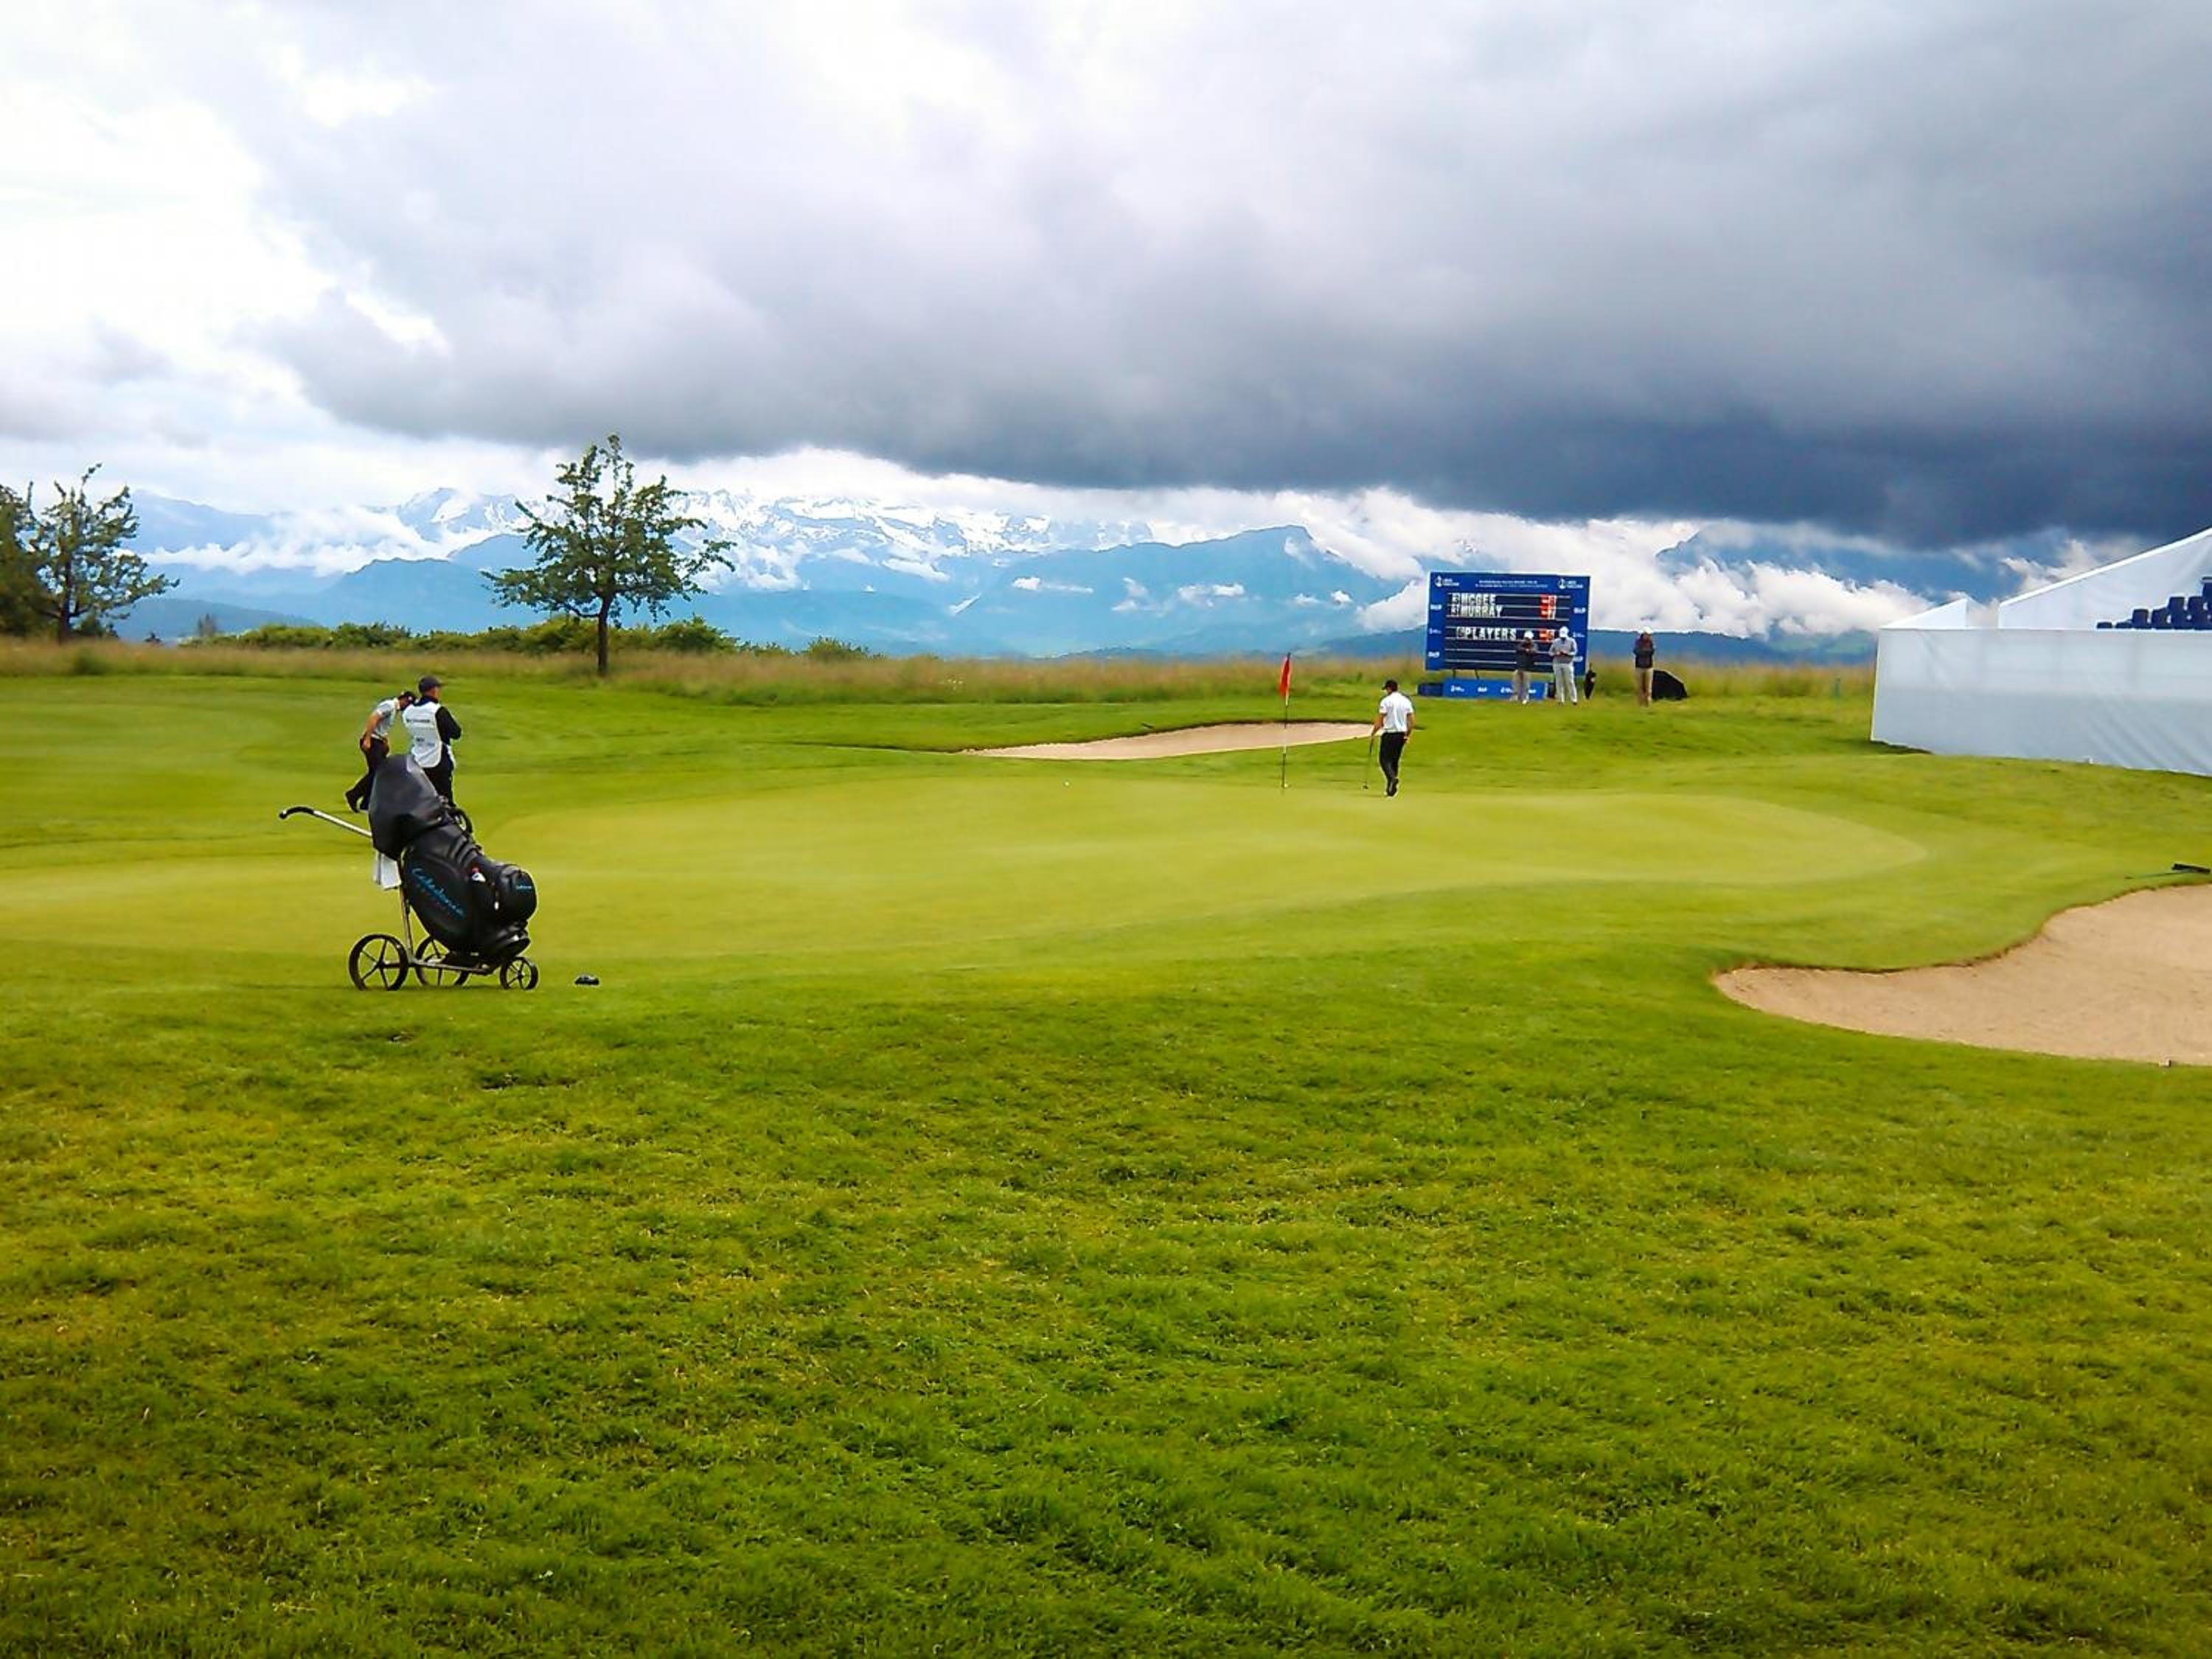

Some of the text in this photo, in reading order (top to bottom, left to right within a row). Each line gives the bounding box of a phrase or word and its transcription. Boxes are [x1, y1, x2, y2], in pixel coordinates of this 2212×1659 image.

[1461, 593, 1496, 605] MCGEE
[1461, 605, 1503, 617] MURRAY
[1465, 627, 1517, 640] PLAYERS
